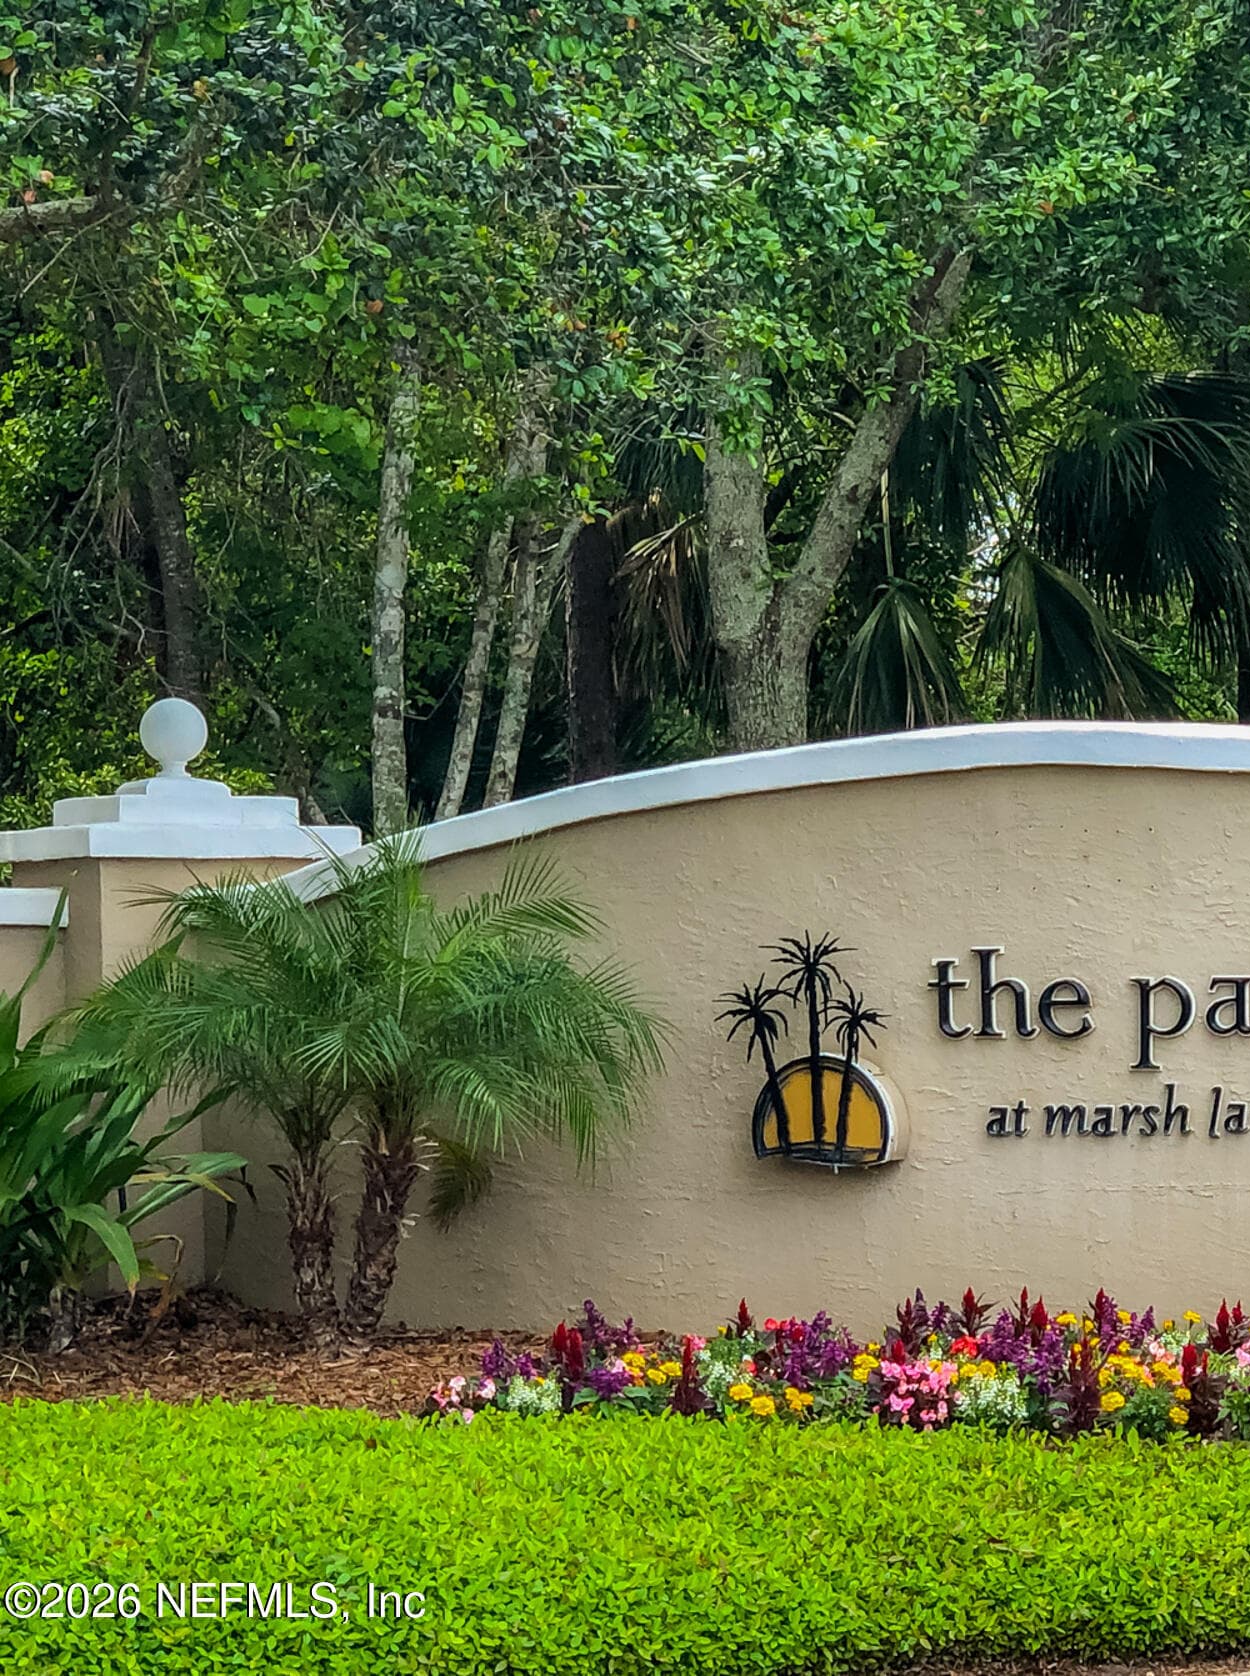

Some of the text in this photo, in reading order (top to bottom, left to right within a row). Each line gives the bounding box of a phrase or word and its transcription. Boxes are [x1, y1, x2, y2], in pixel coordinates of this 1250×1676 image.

[927, 946, 1095, 1040] the
[985, 1099, 1029, 1138] at
[1043, 1083, 1192, 1138] marsh
